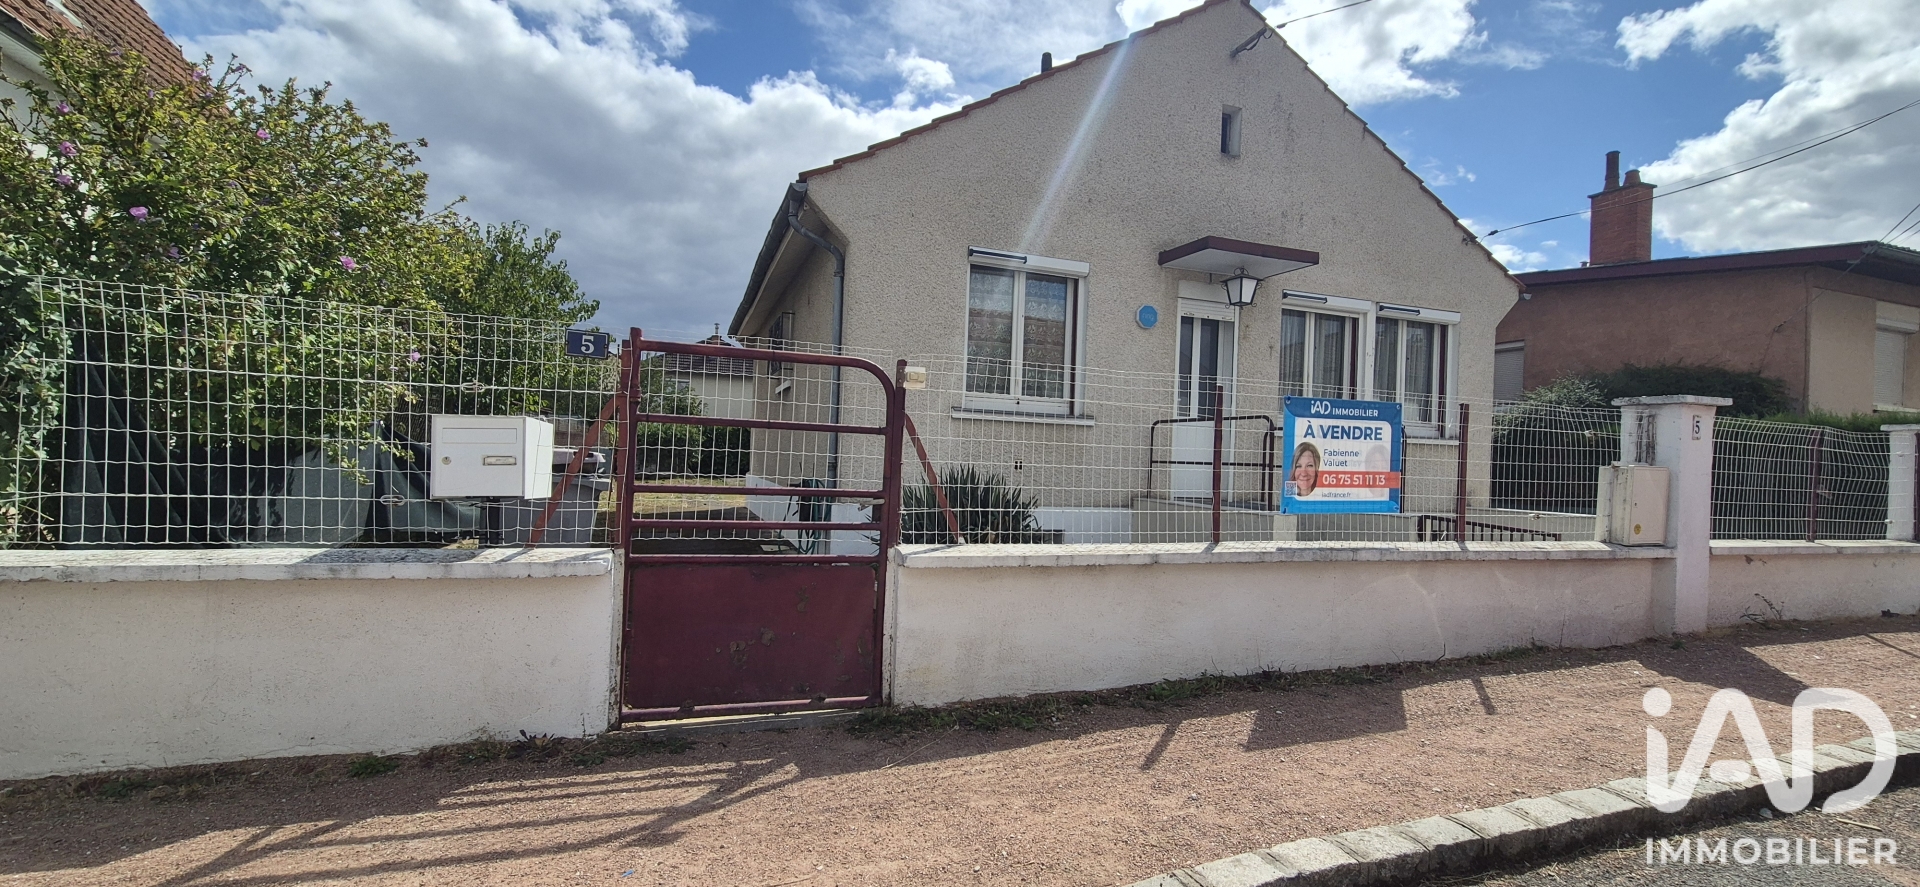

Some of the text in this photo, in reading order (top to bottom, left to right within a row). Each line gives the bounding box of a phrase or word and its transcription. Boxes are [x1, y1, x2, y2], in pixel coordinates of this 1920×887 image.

[580, 335, 594, 354] 5
[1332, 408, 1379, 417] IMMOBILIER
[1303, 420, 1383, 440] À VENDRE
[1694, 420, 1700, 434] 5
[1324, 449, 1360, 457] Fabienne
[1323, 459, 1348, 467] Valuet
[1323, 474, 1386, 486] 06 75 51 11 13
